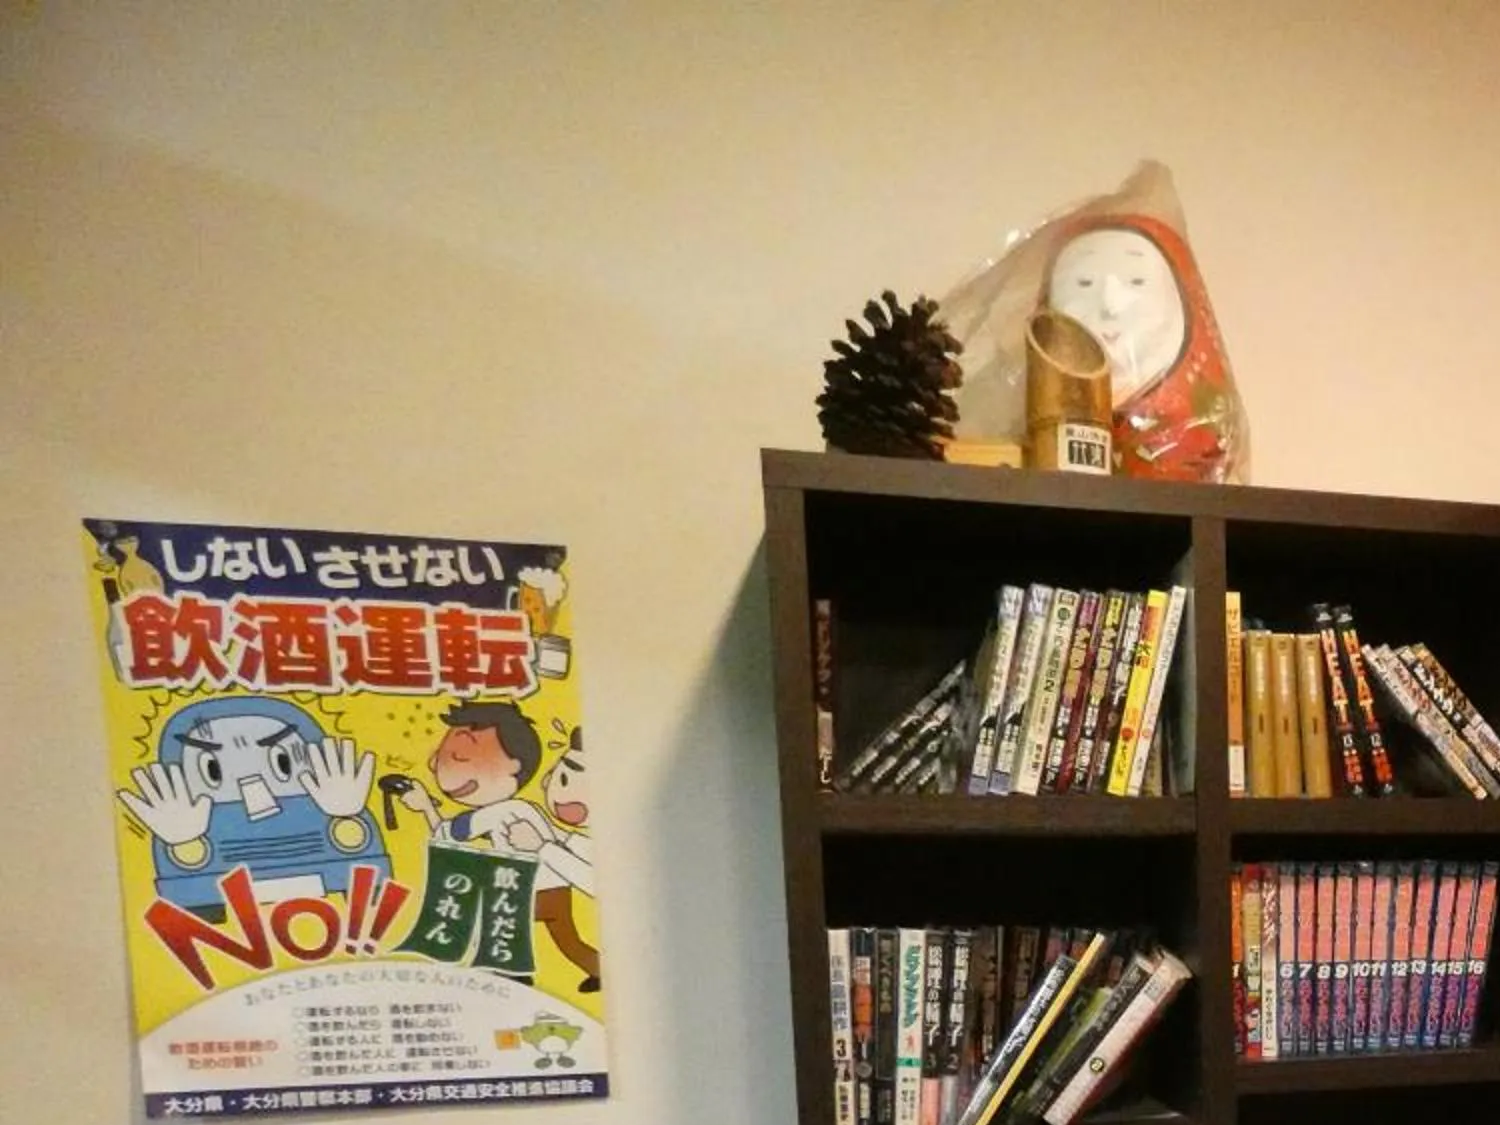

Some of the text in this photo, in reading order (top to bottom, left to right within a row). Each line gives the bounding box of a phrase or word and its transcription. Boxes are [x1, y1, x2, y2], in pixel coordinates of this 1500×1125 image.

[161, 537, 504, 590] しない させない
[121, 597, 532, 692] 飲酒運転
[425, 873, 473, 946] のれん
[491, 866, 521, 964] 飲んだら
